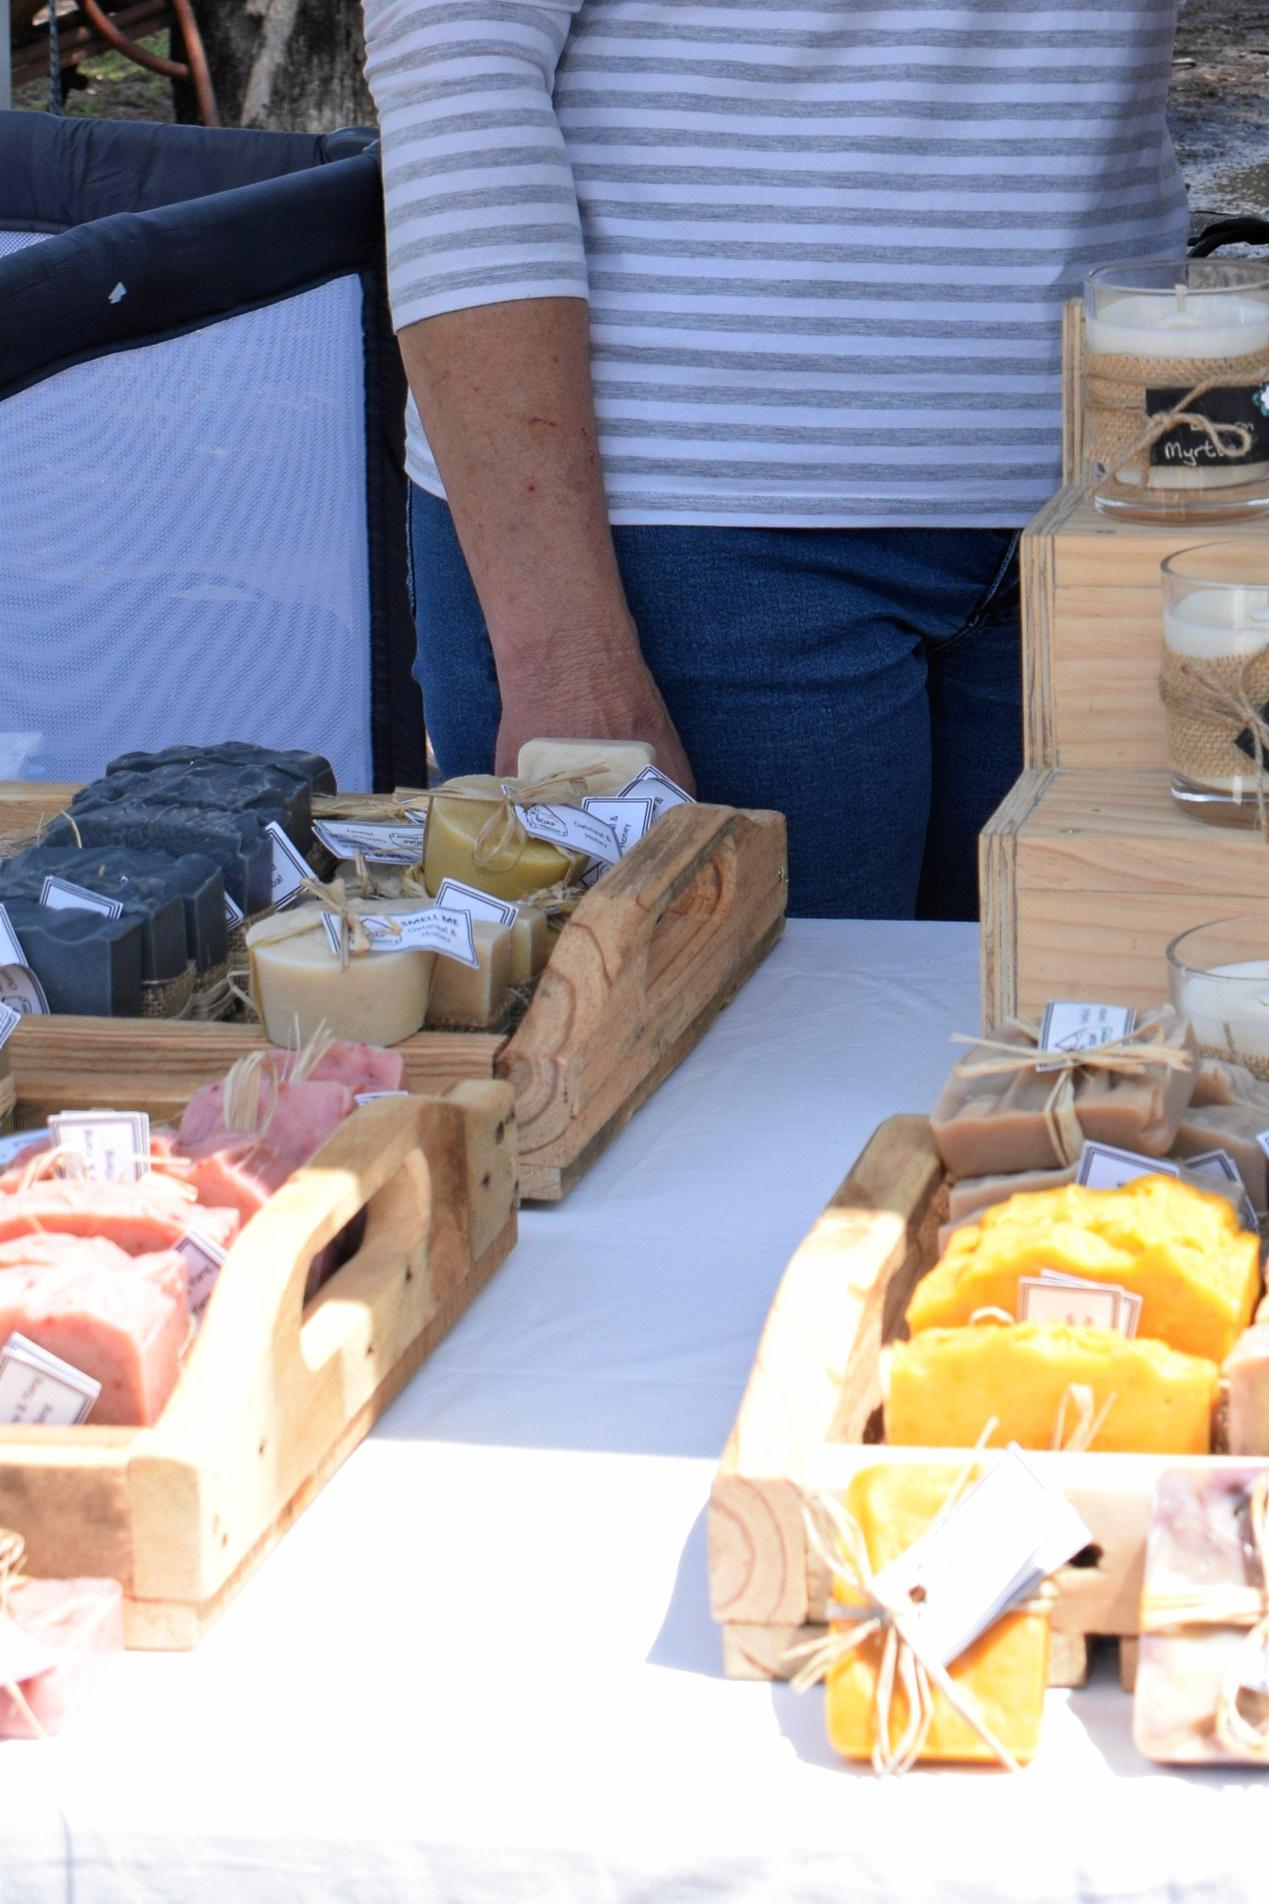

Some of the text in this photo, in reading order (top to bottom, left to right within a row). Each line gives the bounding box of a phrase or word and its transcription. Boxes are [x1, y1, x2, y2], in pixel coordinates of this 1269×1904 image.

[1165, 442, 1240, 466] Myrt
[401, 914, 459, 927] SMELL ME
